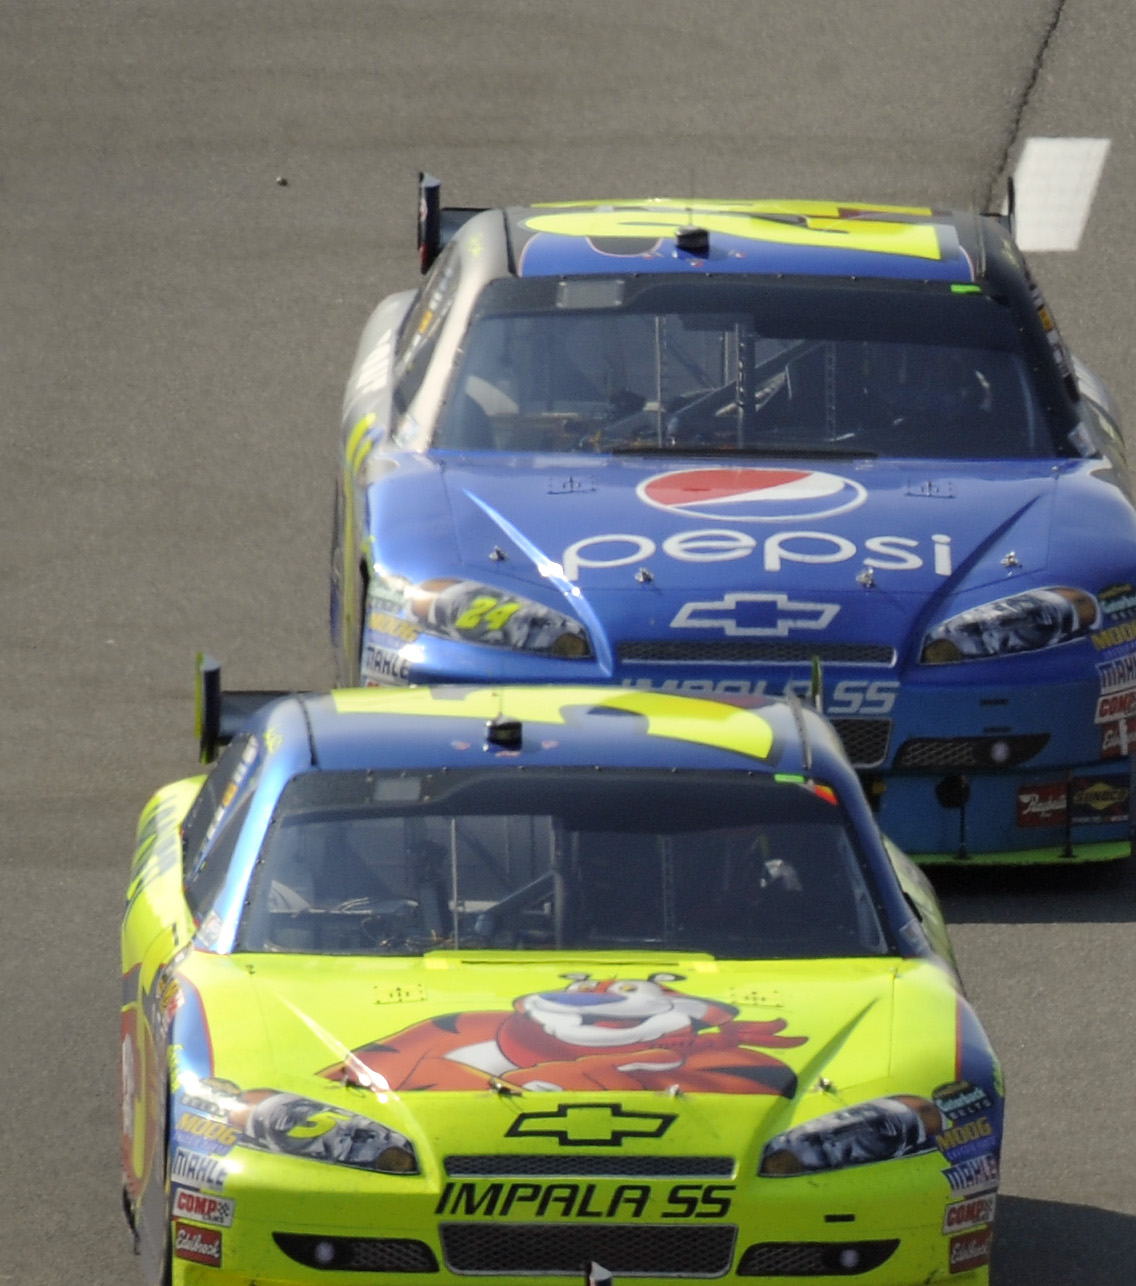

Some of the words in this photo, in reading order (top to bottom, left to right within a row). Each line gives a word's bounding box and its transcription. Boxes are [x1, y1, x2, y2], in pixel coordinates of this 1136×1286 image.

[563, 528, 952, 581] pepsi
[455, 596, 521, 630] 24
[828, 680, 900, 714] SS
[178, 1113, 241, 1145] MOOG
[287, 1111, 351, 1139] 5
[935, 1117, 992, 1151] MOOG
[172, 1150, 228, 1186] MAHLE
[176, 1192, 218, 1216] COMP
[434, 1182, 651, 1216] IMPALA
[661, 1184, 736, 1218] SS
